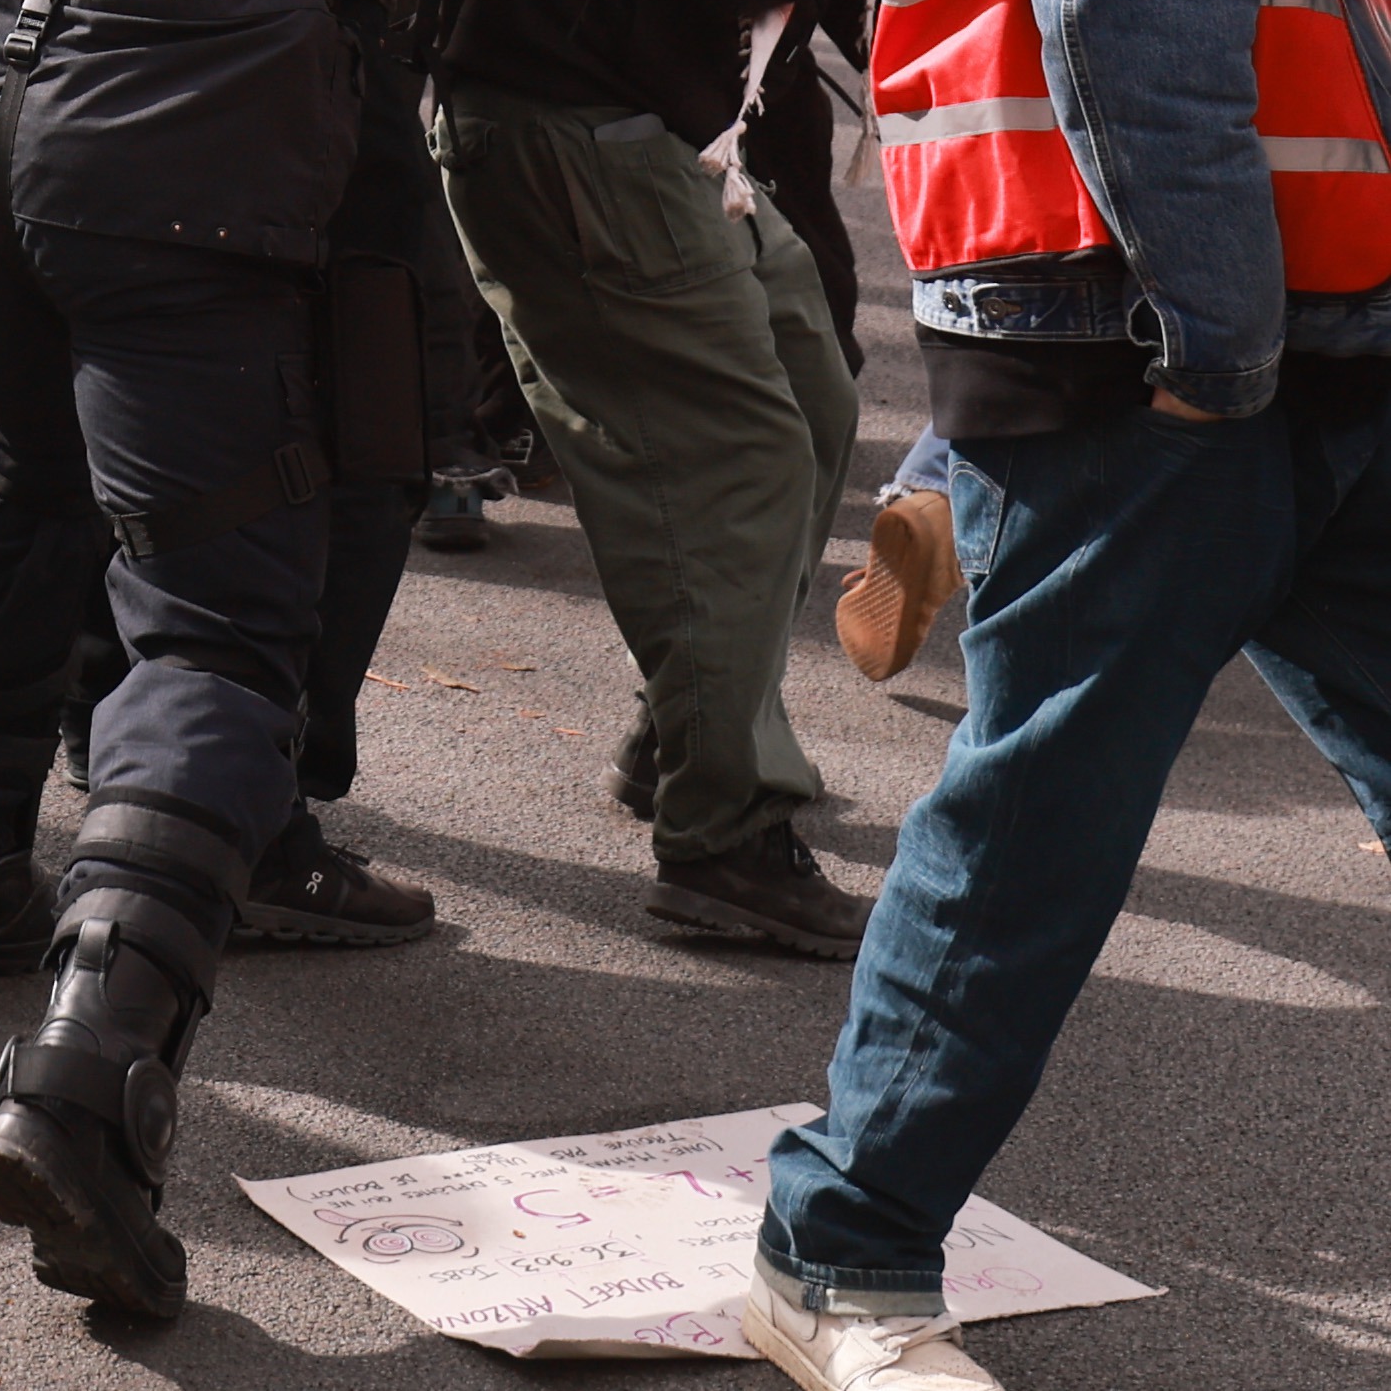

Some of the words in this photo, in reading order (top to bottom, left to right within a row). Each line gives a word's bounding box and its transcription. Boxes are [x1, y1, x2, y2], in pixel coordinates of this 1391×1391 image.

[550, 1148, 587, 1160] PAS
[513, 1189, 592, 1229] 5
[699, 1262, 749, 1279] LE
[566, 1272, 684, 1309] BUDGET
